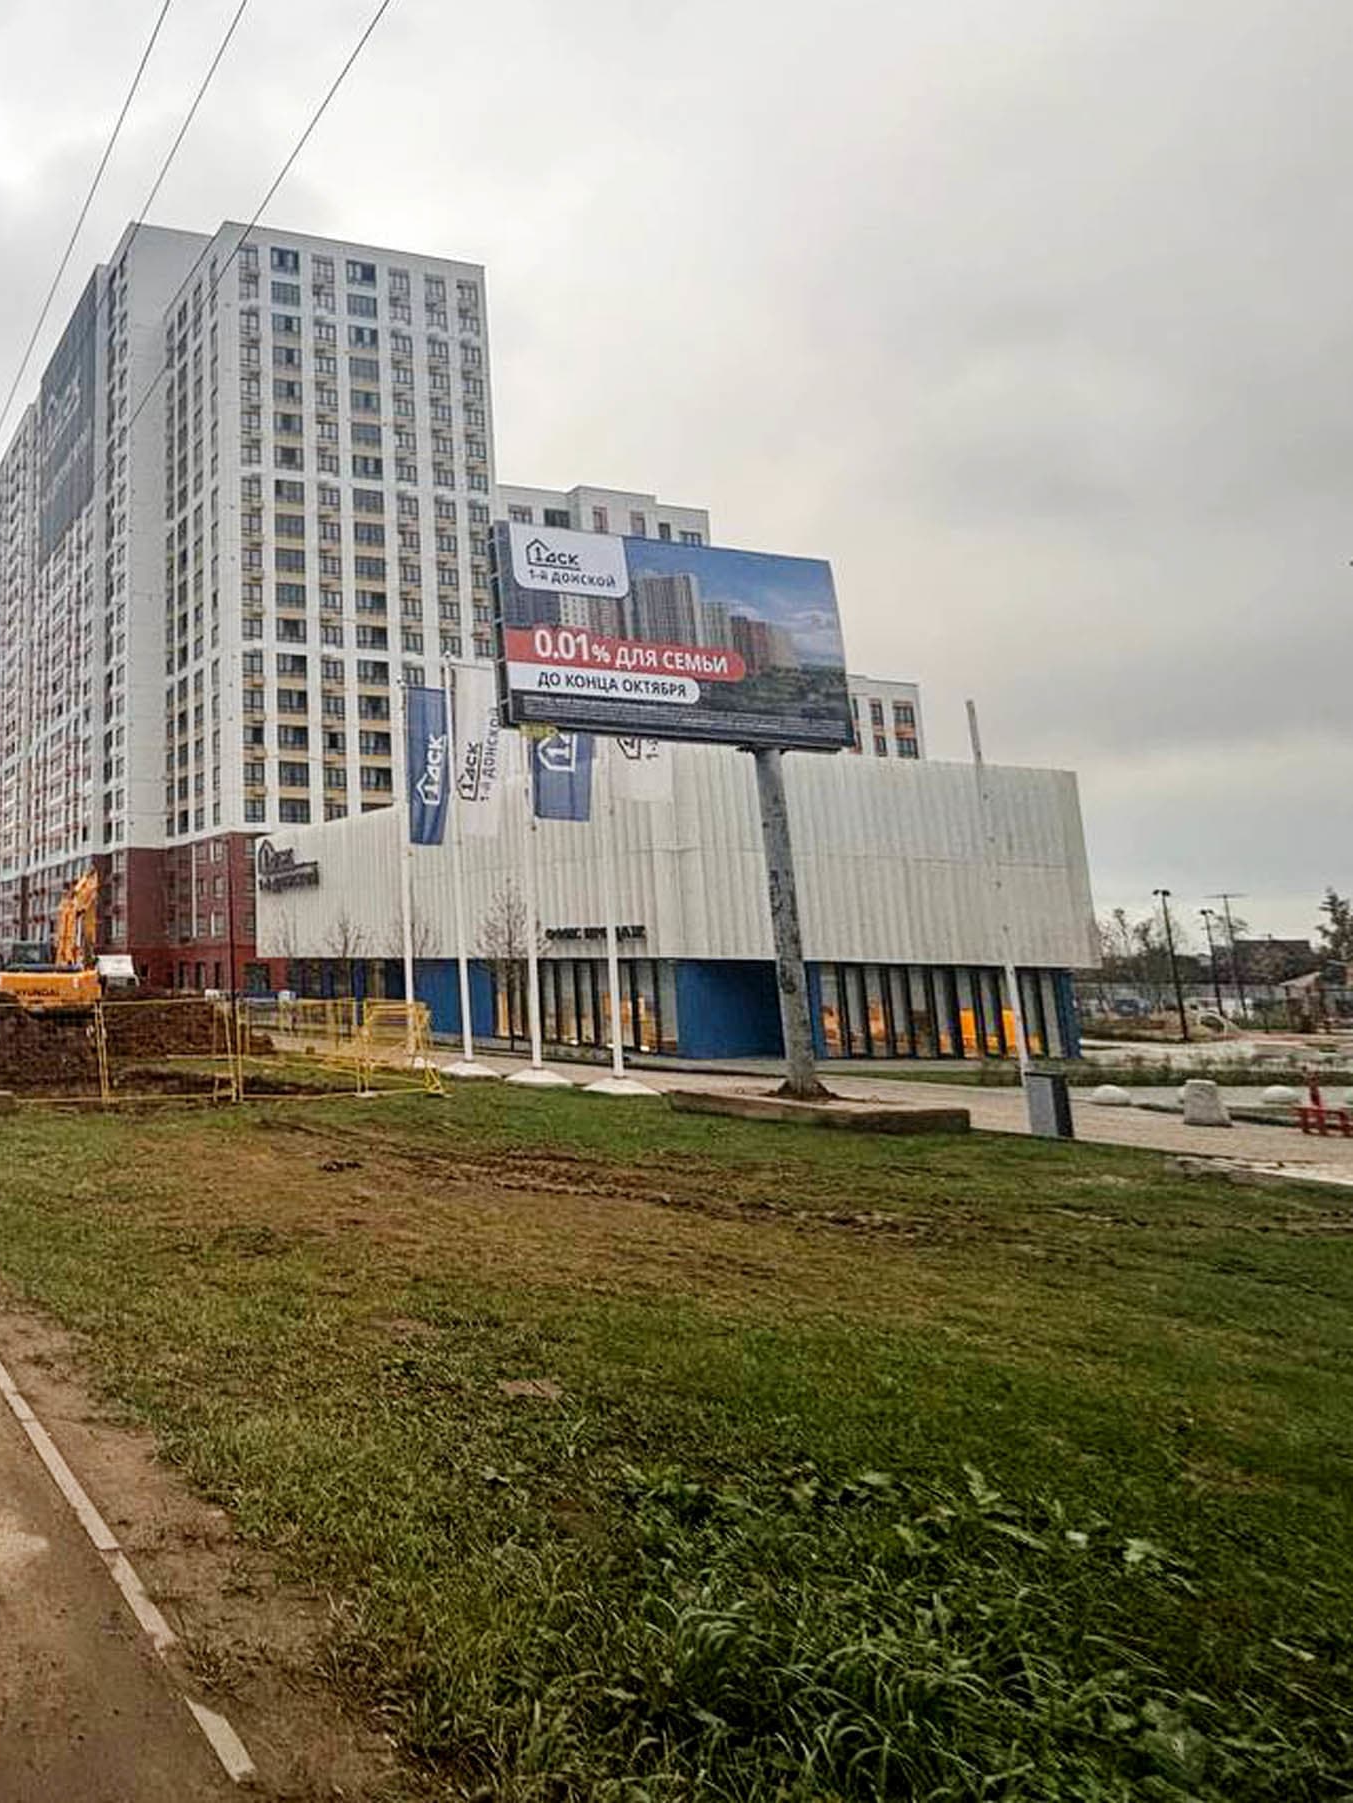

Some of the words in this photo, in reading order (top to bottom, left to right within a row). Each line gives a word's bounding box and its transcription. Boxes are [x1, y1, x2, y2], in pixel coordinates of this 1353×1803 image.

[551, 571, 616, 588] ДОНСКОЙ
[615, 646, 658, 670] ДЛЯ
[662, 651, 728, 674] СЕМЬИ
[538, 671, 561, 688] ДО
[565, 674, 619, 693] КОНЦА
[622, 678, 687, 697] ОКТЯБРЯ
